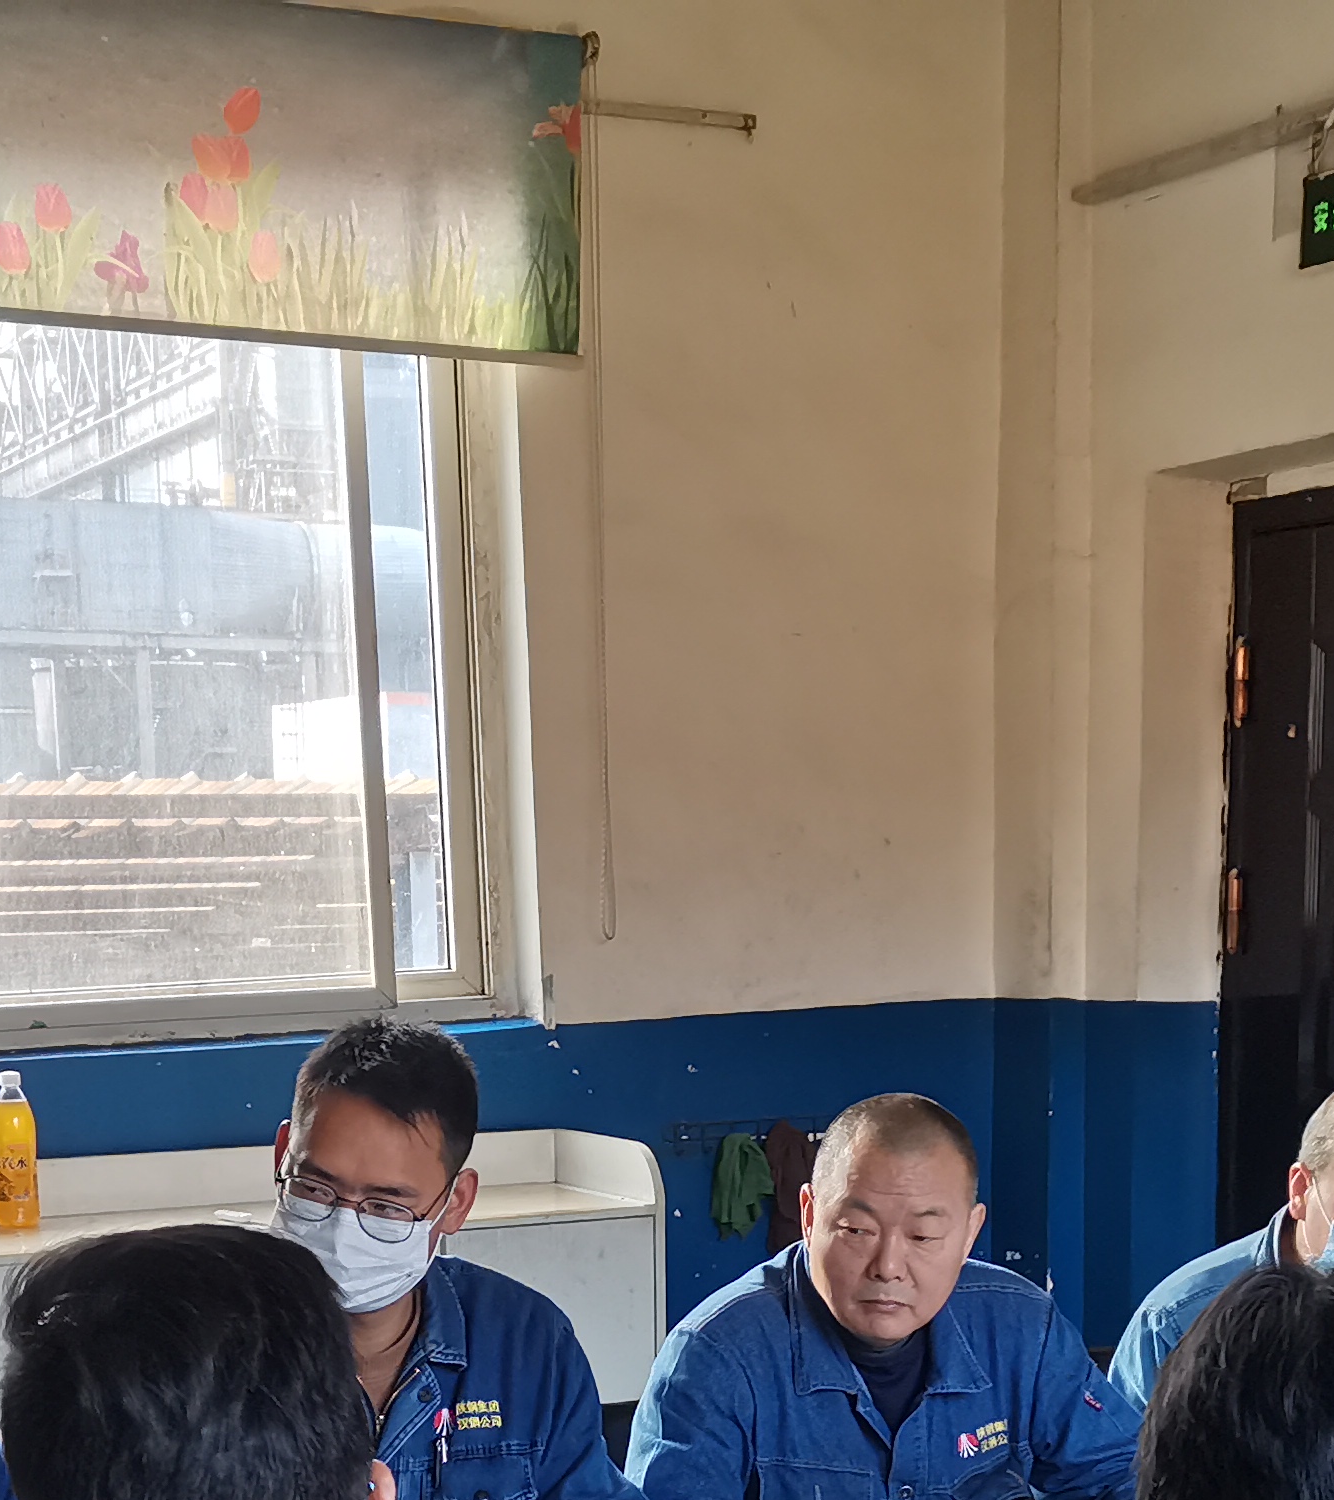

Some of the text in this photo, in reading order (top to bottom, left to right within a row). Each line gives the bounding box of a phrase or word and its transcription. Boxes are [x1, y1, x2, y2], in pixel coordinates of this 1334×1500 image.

[975, 1418, 1008, 1441] 陕钢集
[980, 1432, 1009, 1454] 汉钢公
